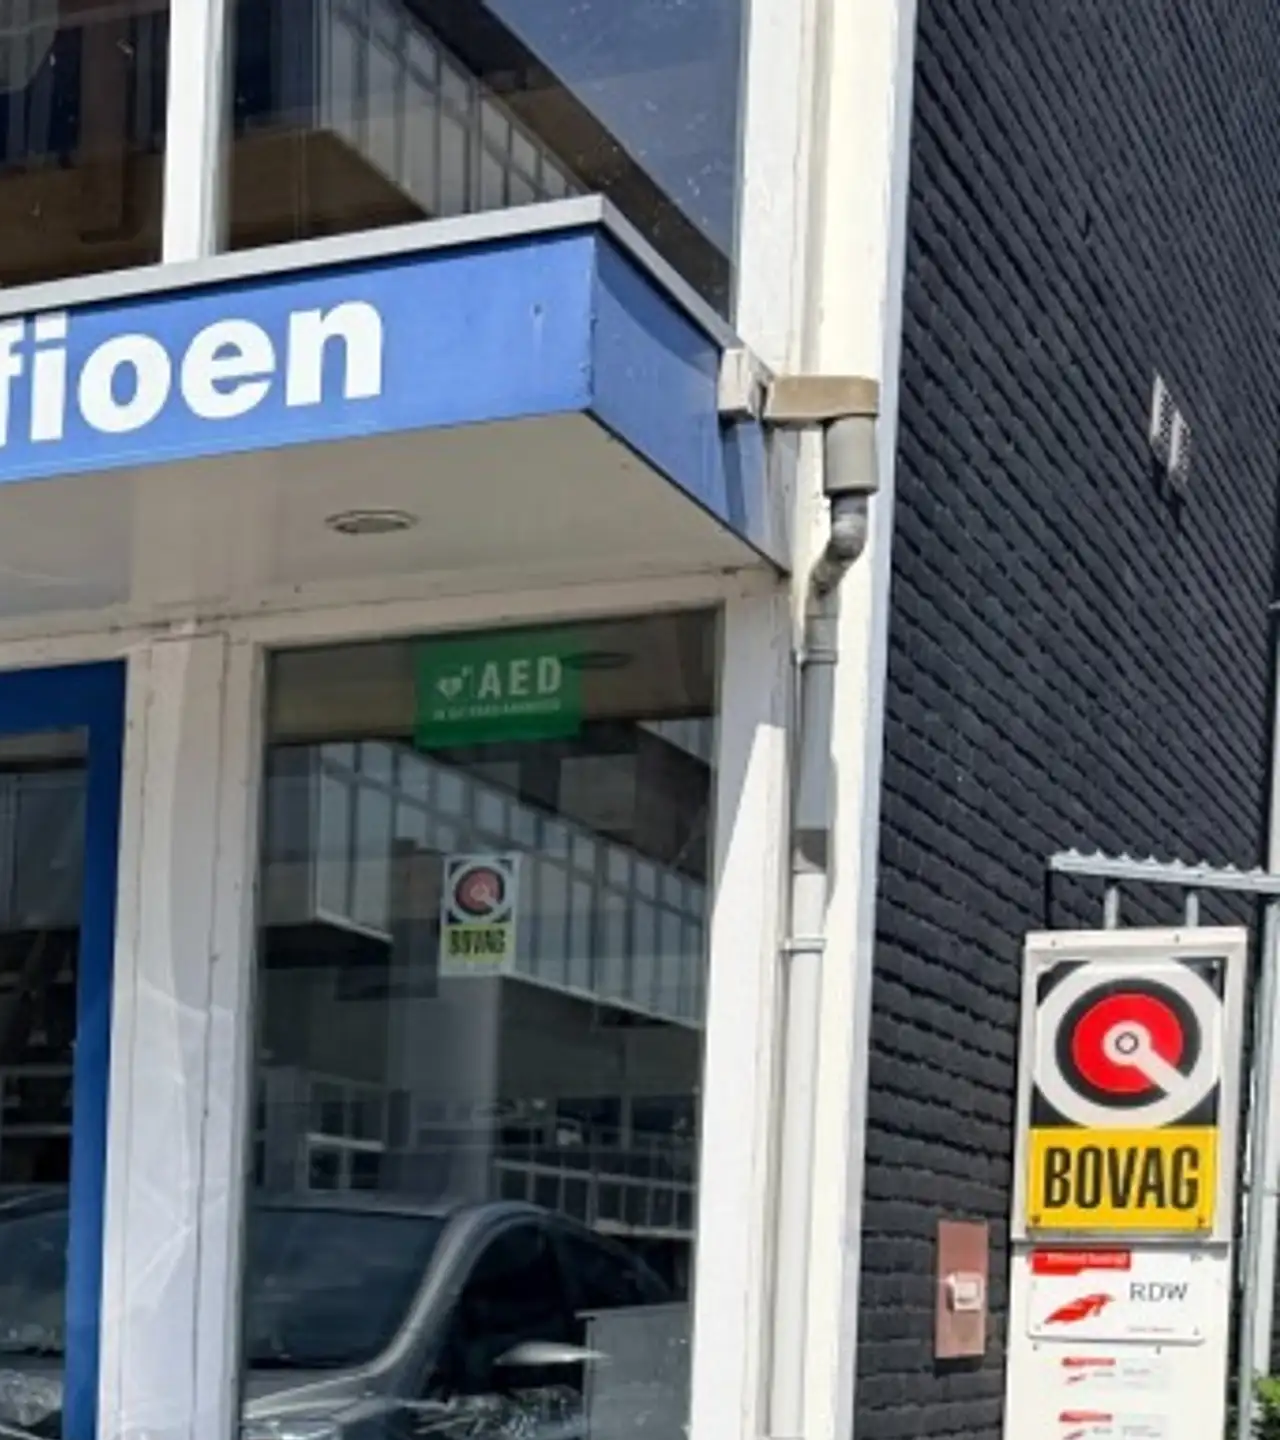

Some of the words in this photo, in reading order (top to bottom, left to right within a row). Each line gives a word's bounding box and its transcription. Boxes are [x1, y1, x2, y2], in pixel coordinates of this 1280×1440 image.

[477, 656, 563, 699] AED
[1043, 1145, 1200, 1210] BOVAG
[1129, 1281, 1188, 1302] RDW
